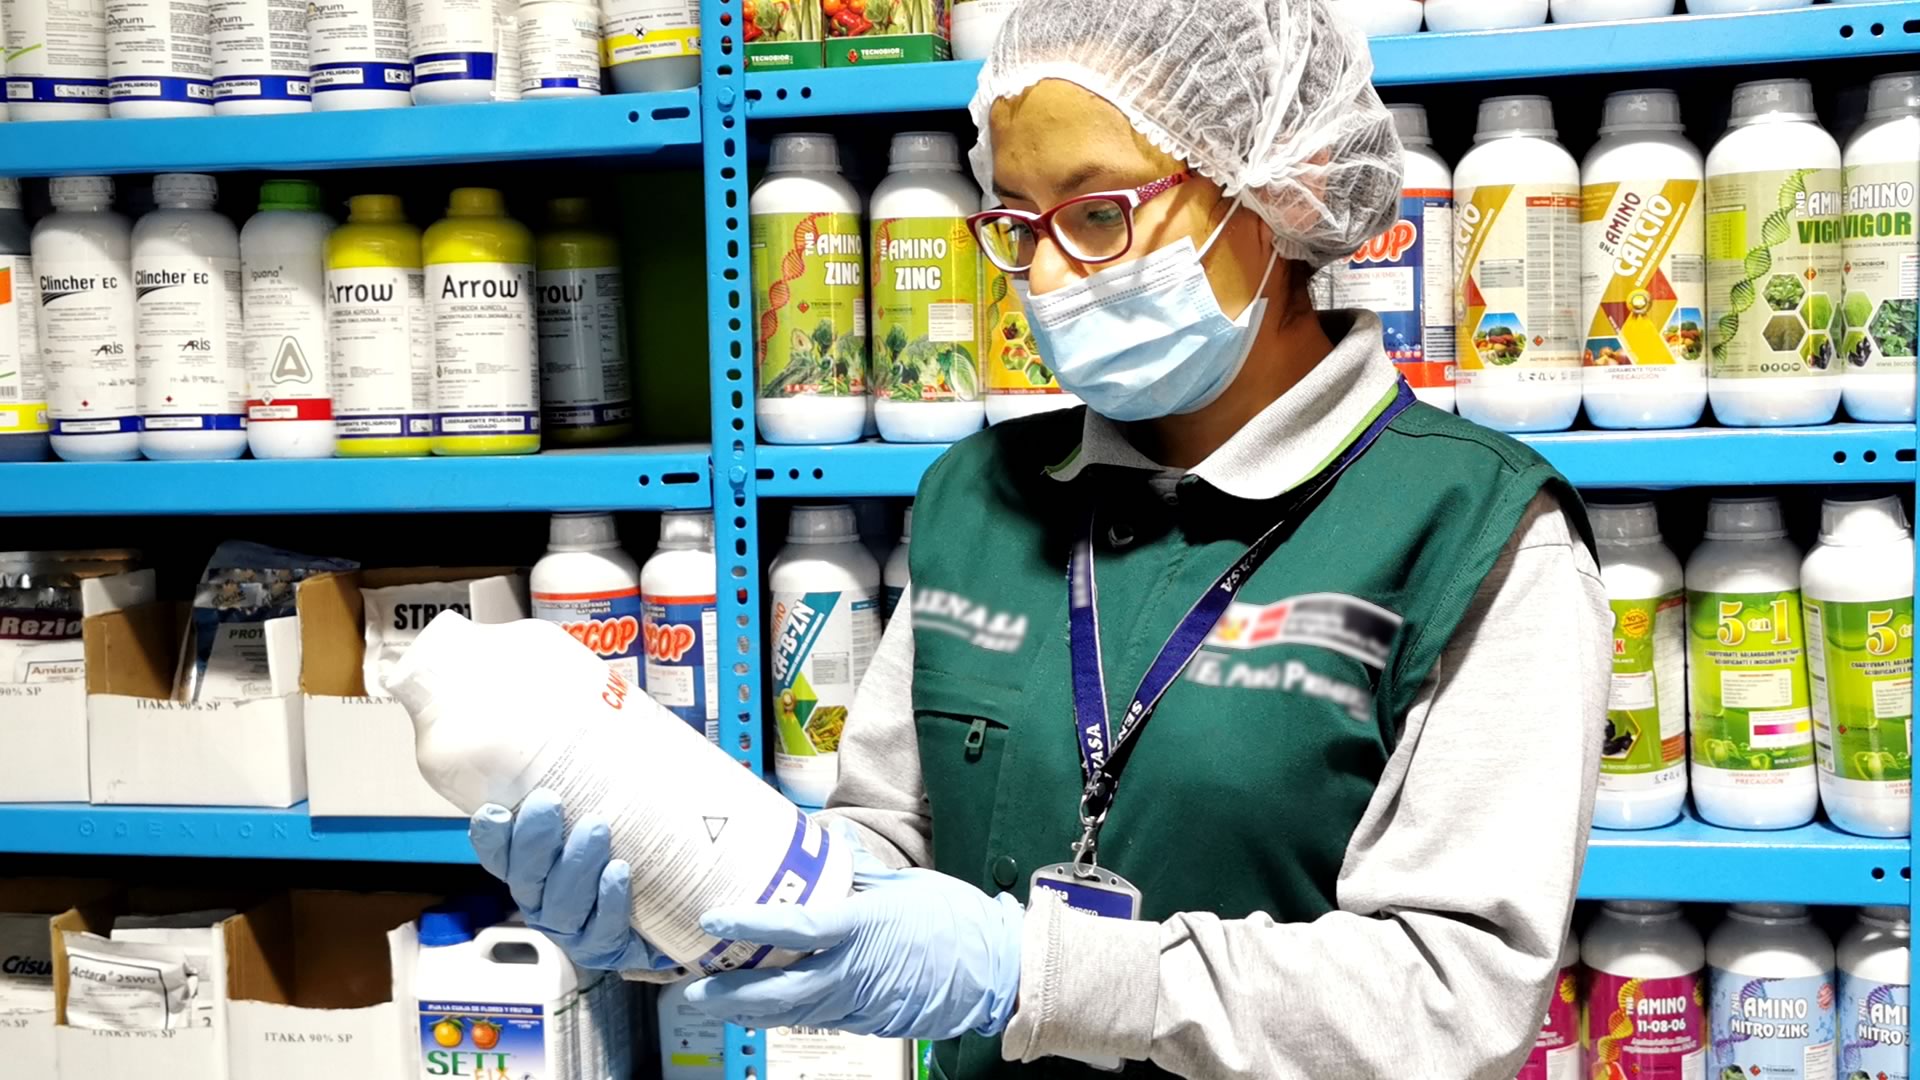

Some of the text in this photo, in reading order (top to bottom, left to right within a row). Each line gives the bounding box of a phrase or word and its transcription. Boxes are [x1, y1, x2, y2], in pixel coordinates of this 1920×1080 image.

[1795, 191, 1805, 217] TNB
[1807, 191, 1841, 218] AMIN
[1849, 182, 1914, 210] AMINO
[1605, 192, 1641, 245] AMINO
[1842, 212, 1912, 239] VIGOR
[1613, 194, 1673, 277] CALCIO
[1796, 219, 1841, 244] VIGO
[803, 231, 813, 256] TNB
[815, 234, 861, 256] AMINO
[887, 237, 946, 261] AMINO
[40, 276, 117, 291] Clincher EC
[135, 270, 208, 286] Clincher EC
[823, 262, 861, 285] ZINC
[893, 266, 941, 291] ZINC
[328, 280, 393, 304] Arrow
[441, 274, 518, 299] Arrow
[0, 617, 82, 636] Rezio
[229, 629, 264, 639] PROT
[1716, 600, 1746, 647] 5
[1866, 608, 1897, 656] 5
[773, 599, 815, 681] CA-B-ZN
[32, 667, 80, 675] Amistar
[27, 687, 41, 696] SP
[206, 702, 221, 710] SP
[3, 956, 53, 974] Crisu
[1637, 996, 1686, 1016] AMINO
[1743, 997, 1808, 1020] AMINO
[1870, 1003, 1910, 1026] AMI
[14, 1020, 28, 1028] SP
[1637, 1018, 1686, 1033] 11-08-06
[1731, 1018, 1809, 1038] NITRO ZINC
[1858, 1024, 1903, 1044] NITRO
[265, 1032, 353, 1043] ITAKA 90% SP
[427, 1050, 511, 1076] SETT
